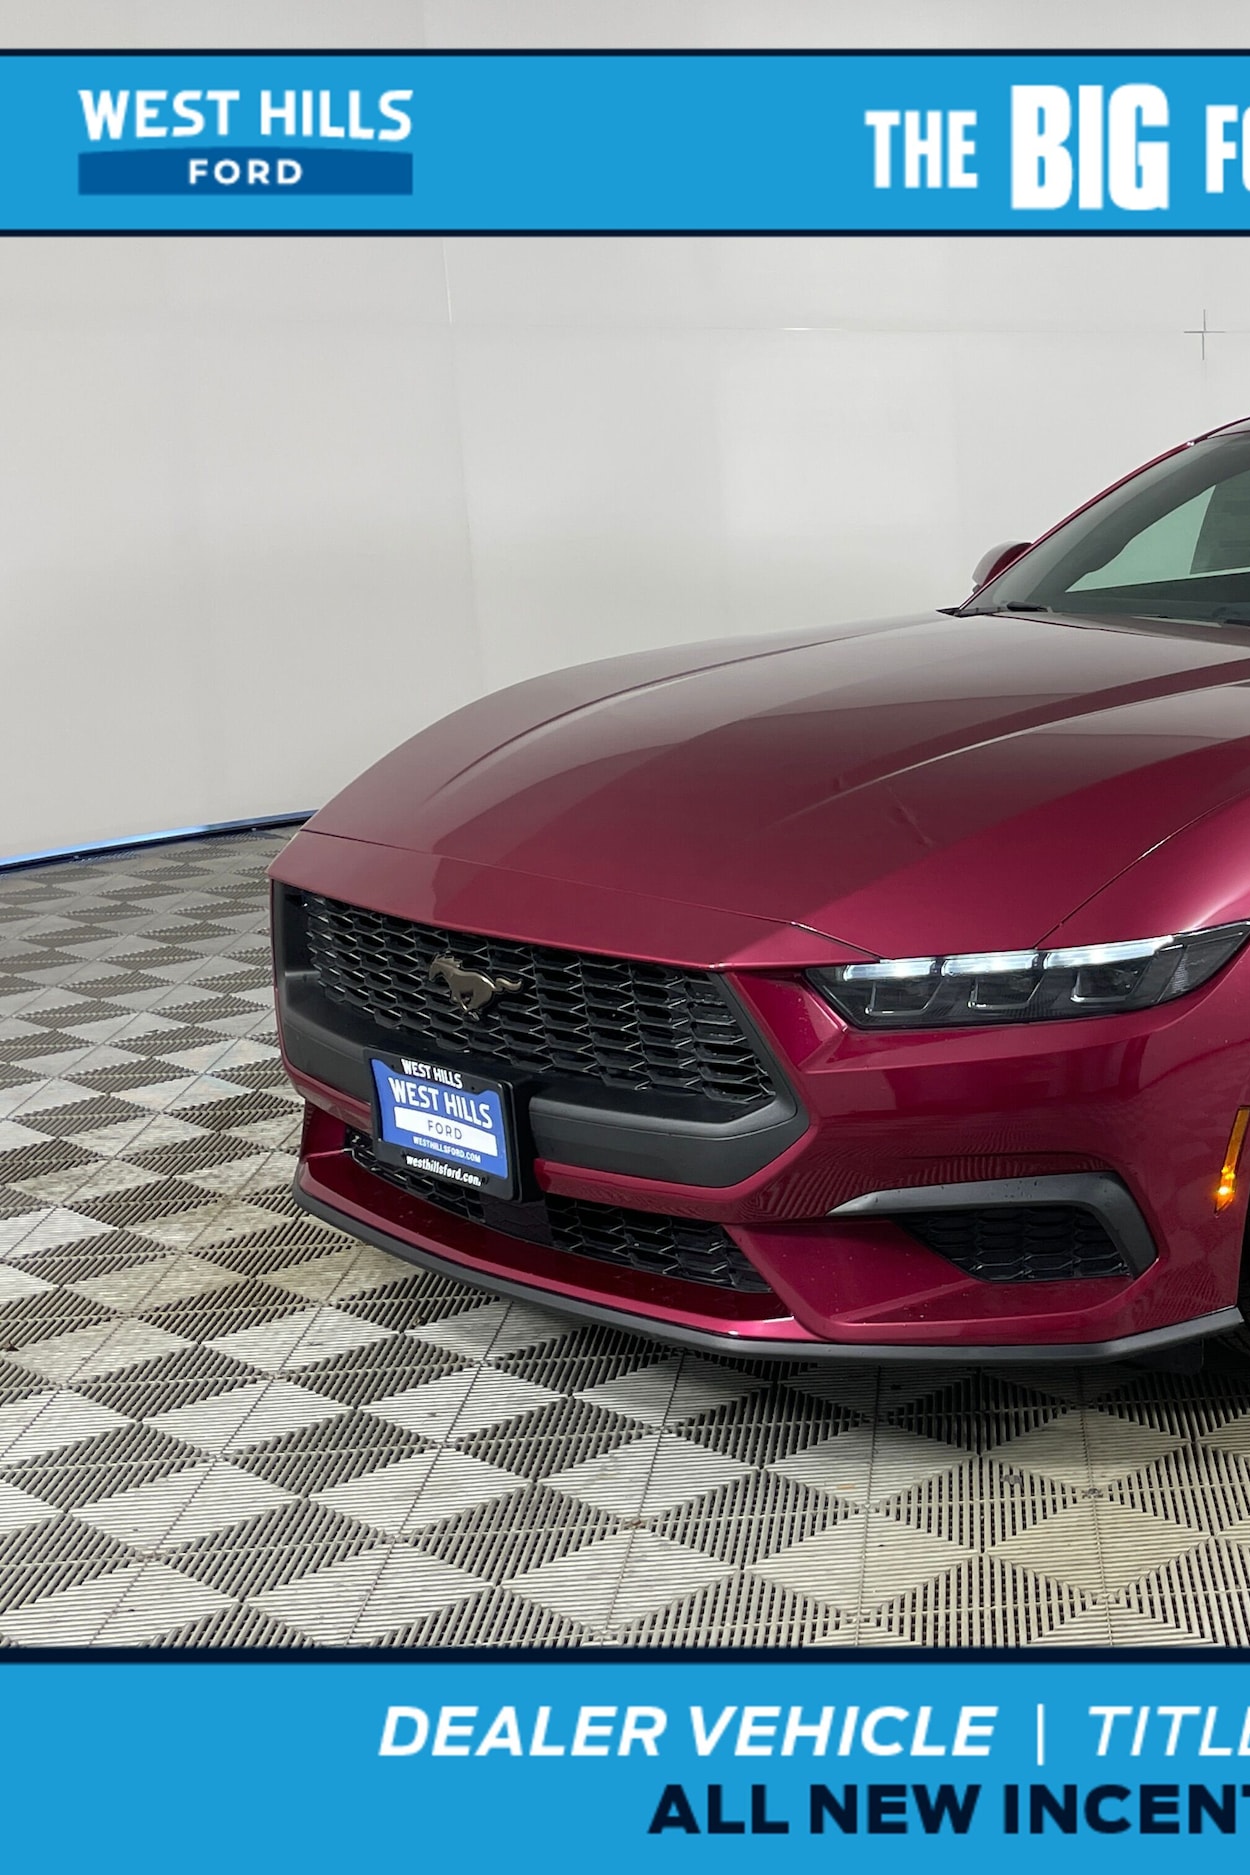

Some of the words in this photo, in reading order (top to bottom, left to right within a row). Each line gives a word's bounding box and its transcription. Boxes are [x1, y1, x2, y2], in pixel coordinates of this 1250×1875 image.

[401, 1058, 432, 1080] WEST
[433, 1067, 464, 1089] HILLS
[388, 1077, 439, 1111] WEST
[444, 1092, 493, 1129] HILLS
[427, 1119, 463, 1141] FORD
[412, 1135, 482, 1164] WESTHILLSFORD.COM
